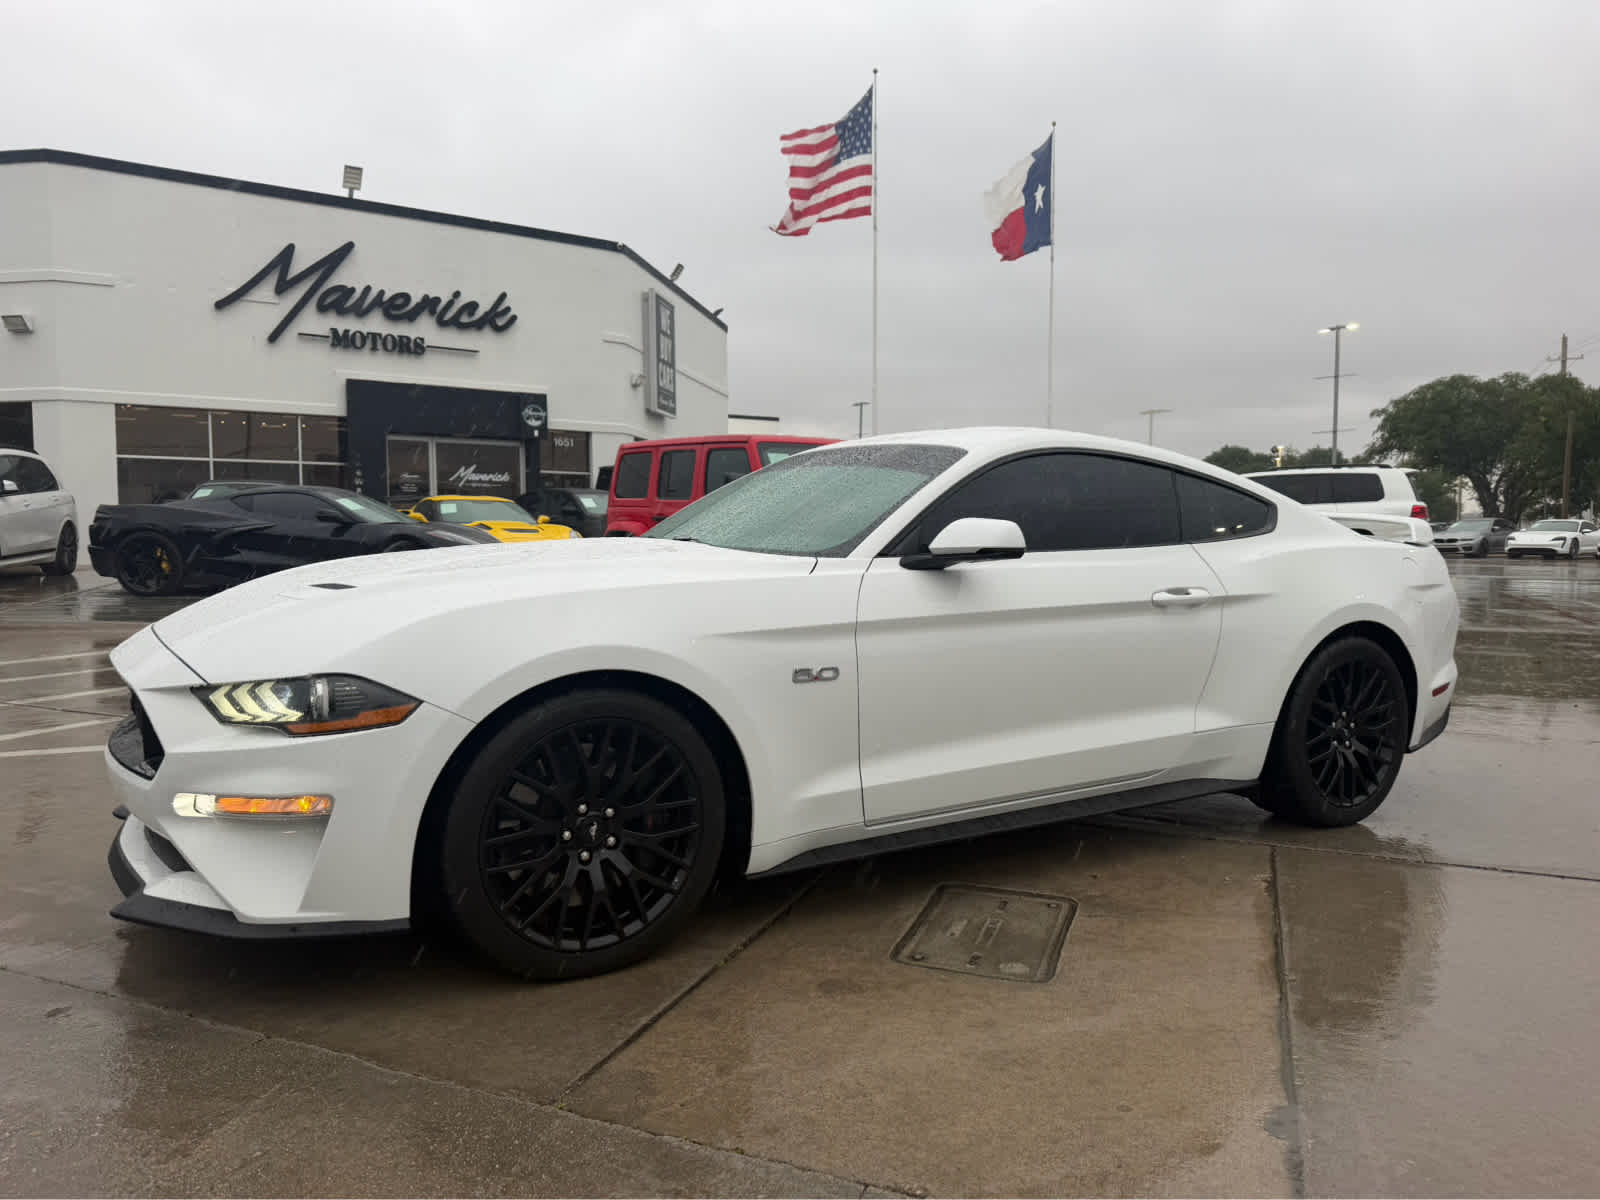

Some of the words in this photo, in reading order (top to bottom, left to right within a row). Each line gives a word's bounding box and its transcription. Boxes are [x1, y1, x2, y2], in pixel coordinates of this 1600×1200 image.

[214, 241, 517, 344] Maverick
[329, 327, 426, 356] MOTORS
[553, 437, 575, 448] 1651
[449, 464, 511, 488] Maverick
